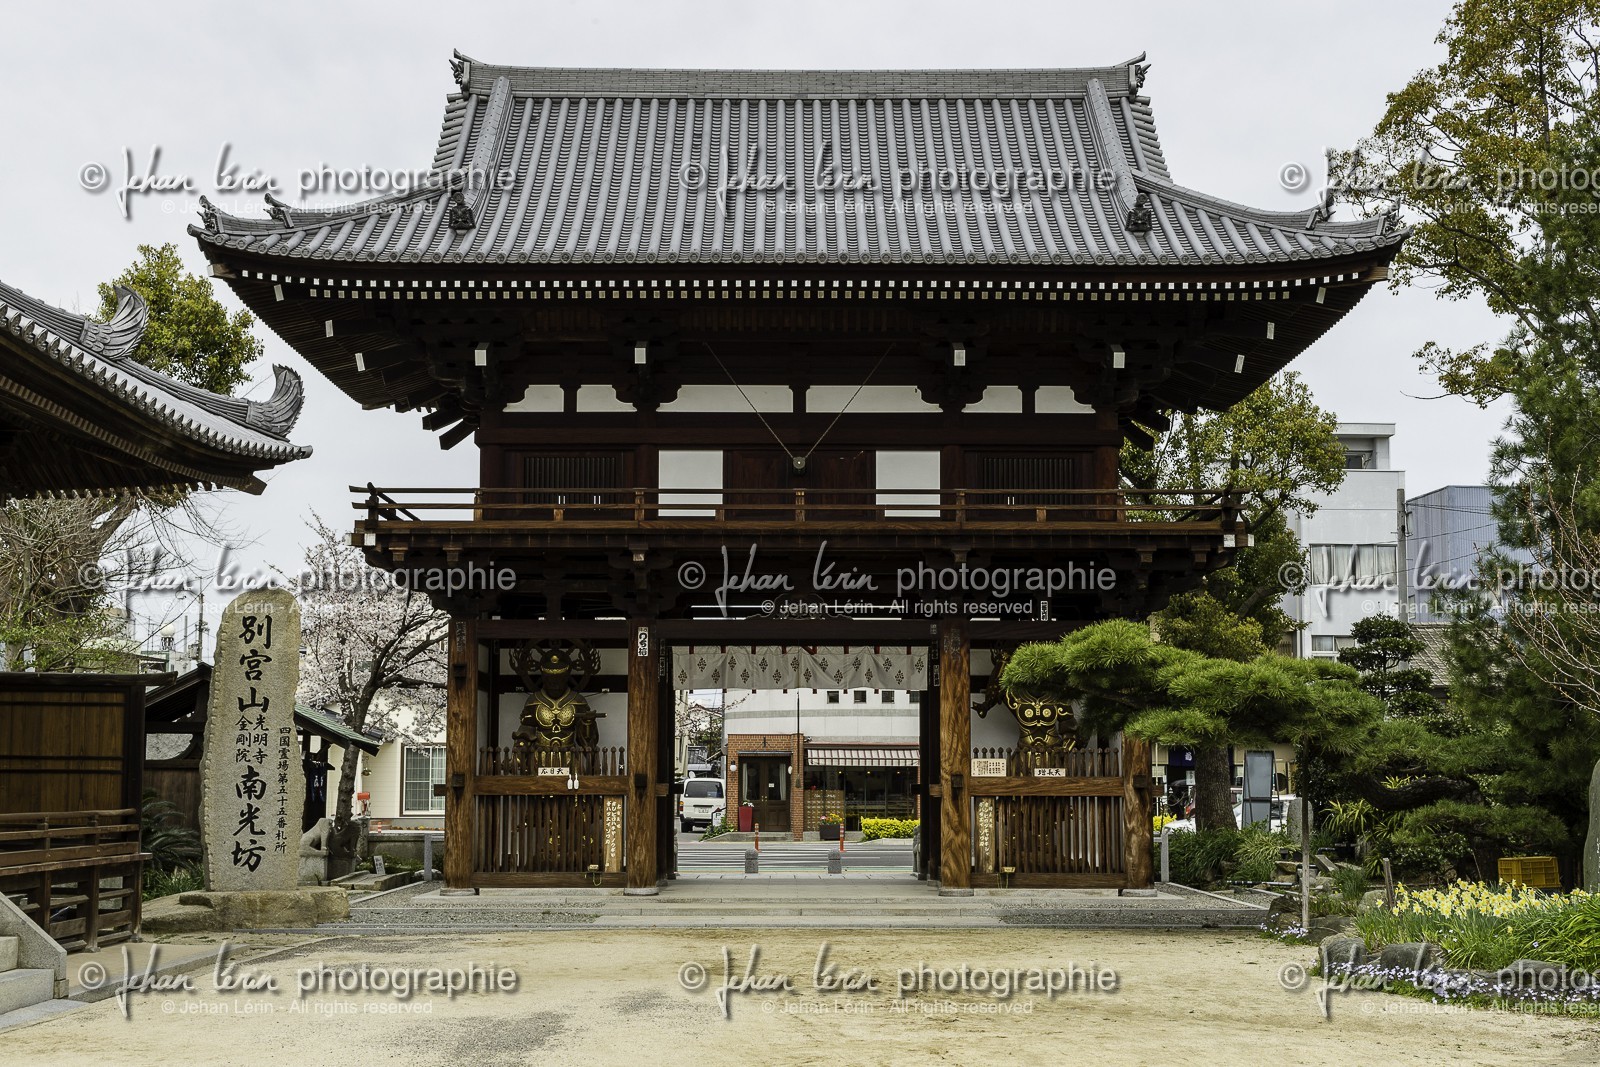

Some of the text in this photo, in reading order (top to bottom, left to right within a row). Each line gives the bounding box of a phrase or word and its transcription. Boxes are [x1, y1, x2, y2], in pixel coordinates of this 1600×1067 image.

[235, 715, 252, 763] 金剛院
[252, 713, 269, 764] 光明寺
